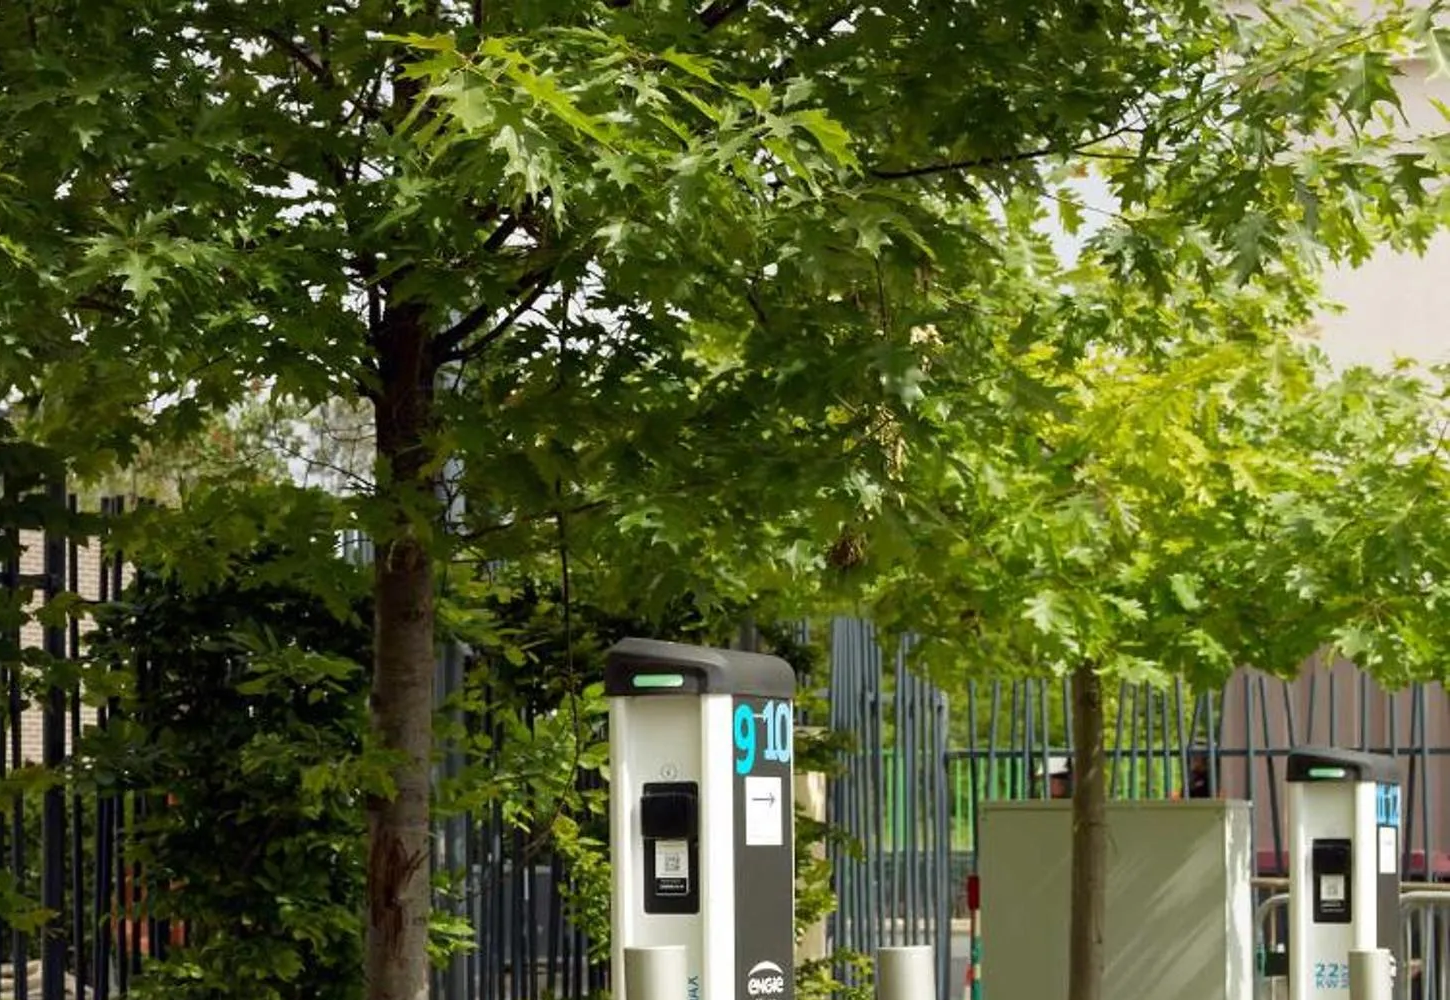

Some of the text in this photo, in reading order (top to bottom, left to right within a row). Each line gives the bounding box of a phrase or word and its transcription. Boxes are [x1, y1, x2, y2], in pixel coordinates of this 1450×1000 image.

[733, 700, 790, 775] 9 10
[1315, 963, 1339, 977] 22
